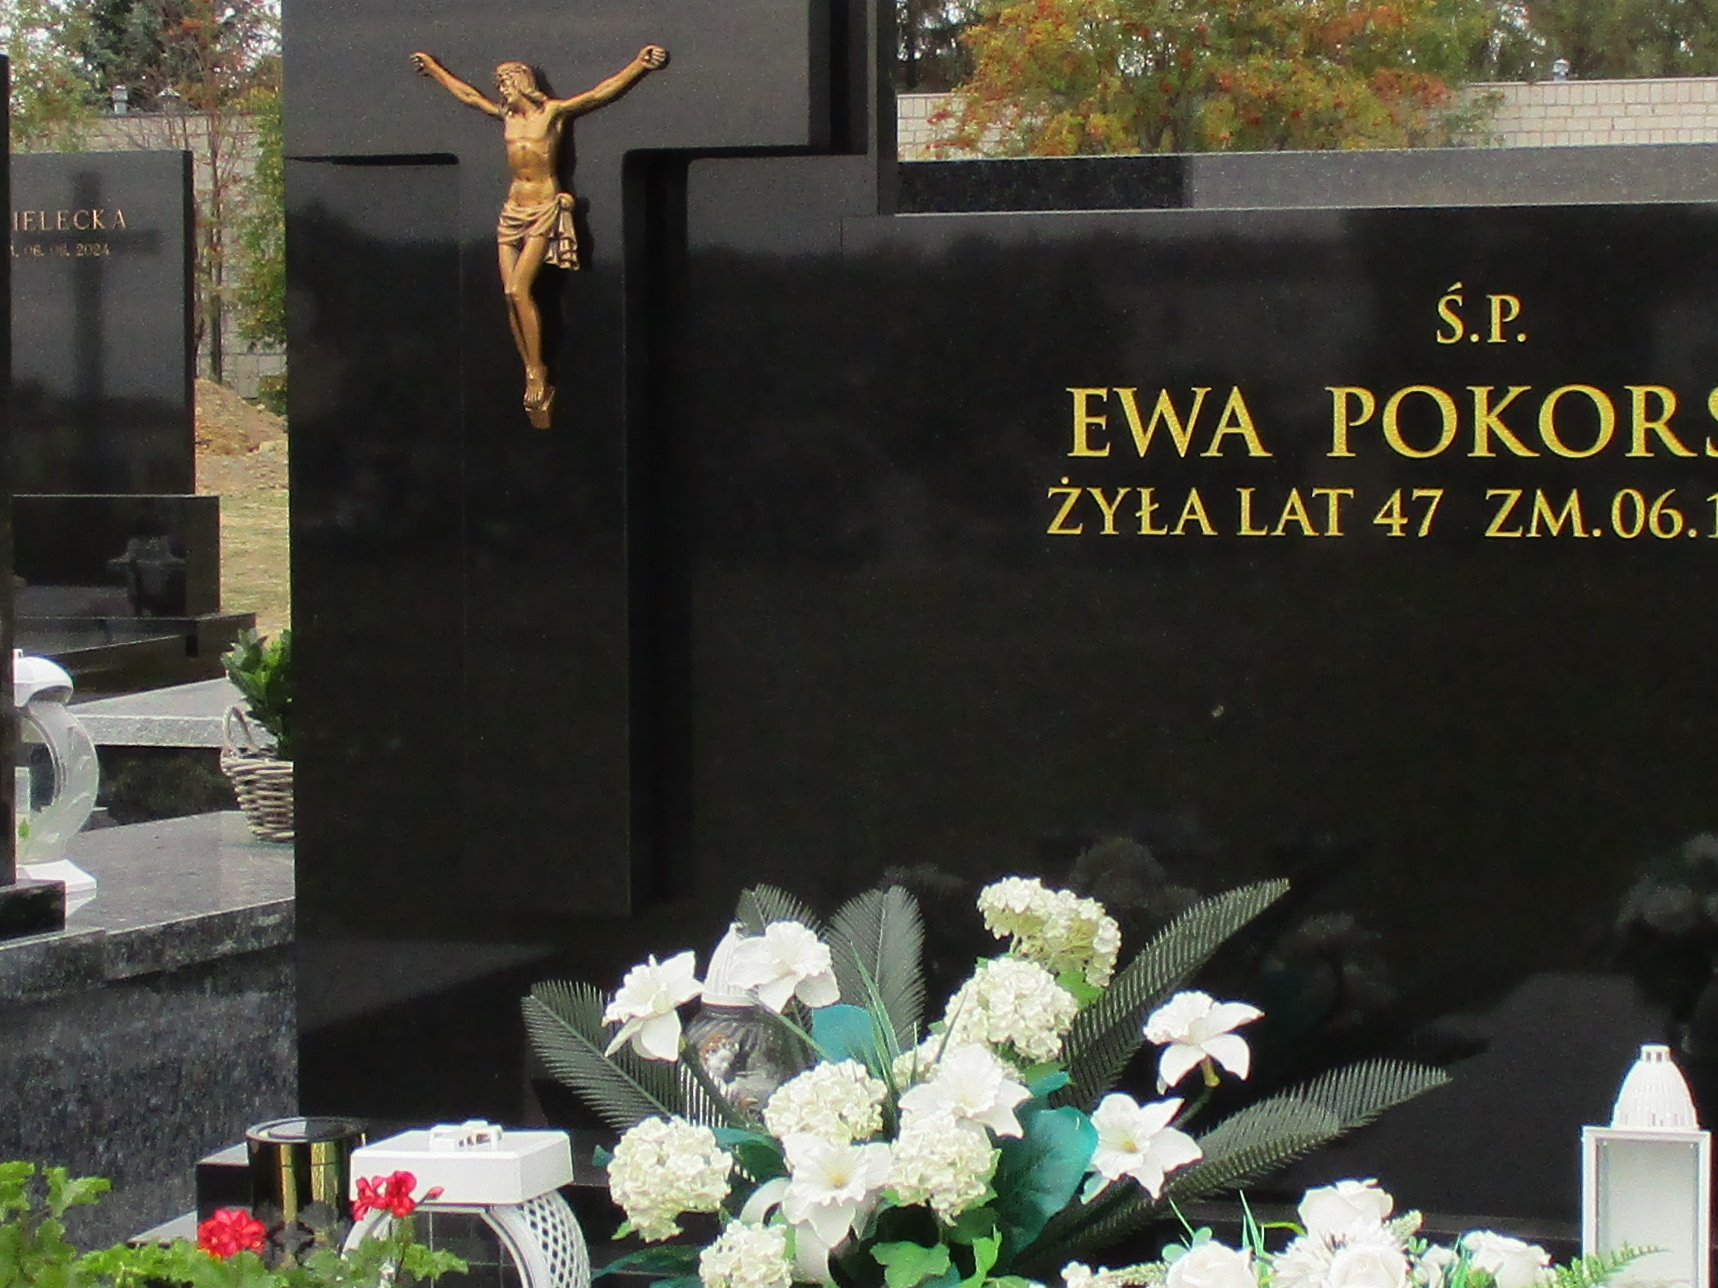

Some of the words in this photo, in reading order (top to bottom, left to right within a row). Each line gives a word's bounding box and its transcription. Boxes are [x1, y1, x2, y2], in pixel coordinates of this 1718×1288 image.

[1436, 282, 1527, 345] Ś.P.
[1066, 386, 1272, 459] EWA
[1046, 476, 1218, 536] ŻYŁA
[1236, 487, 1354, 537] LAT
[1373, 488, 1444, 538] 47
